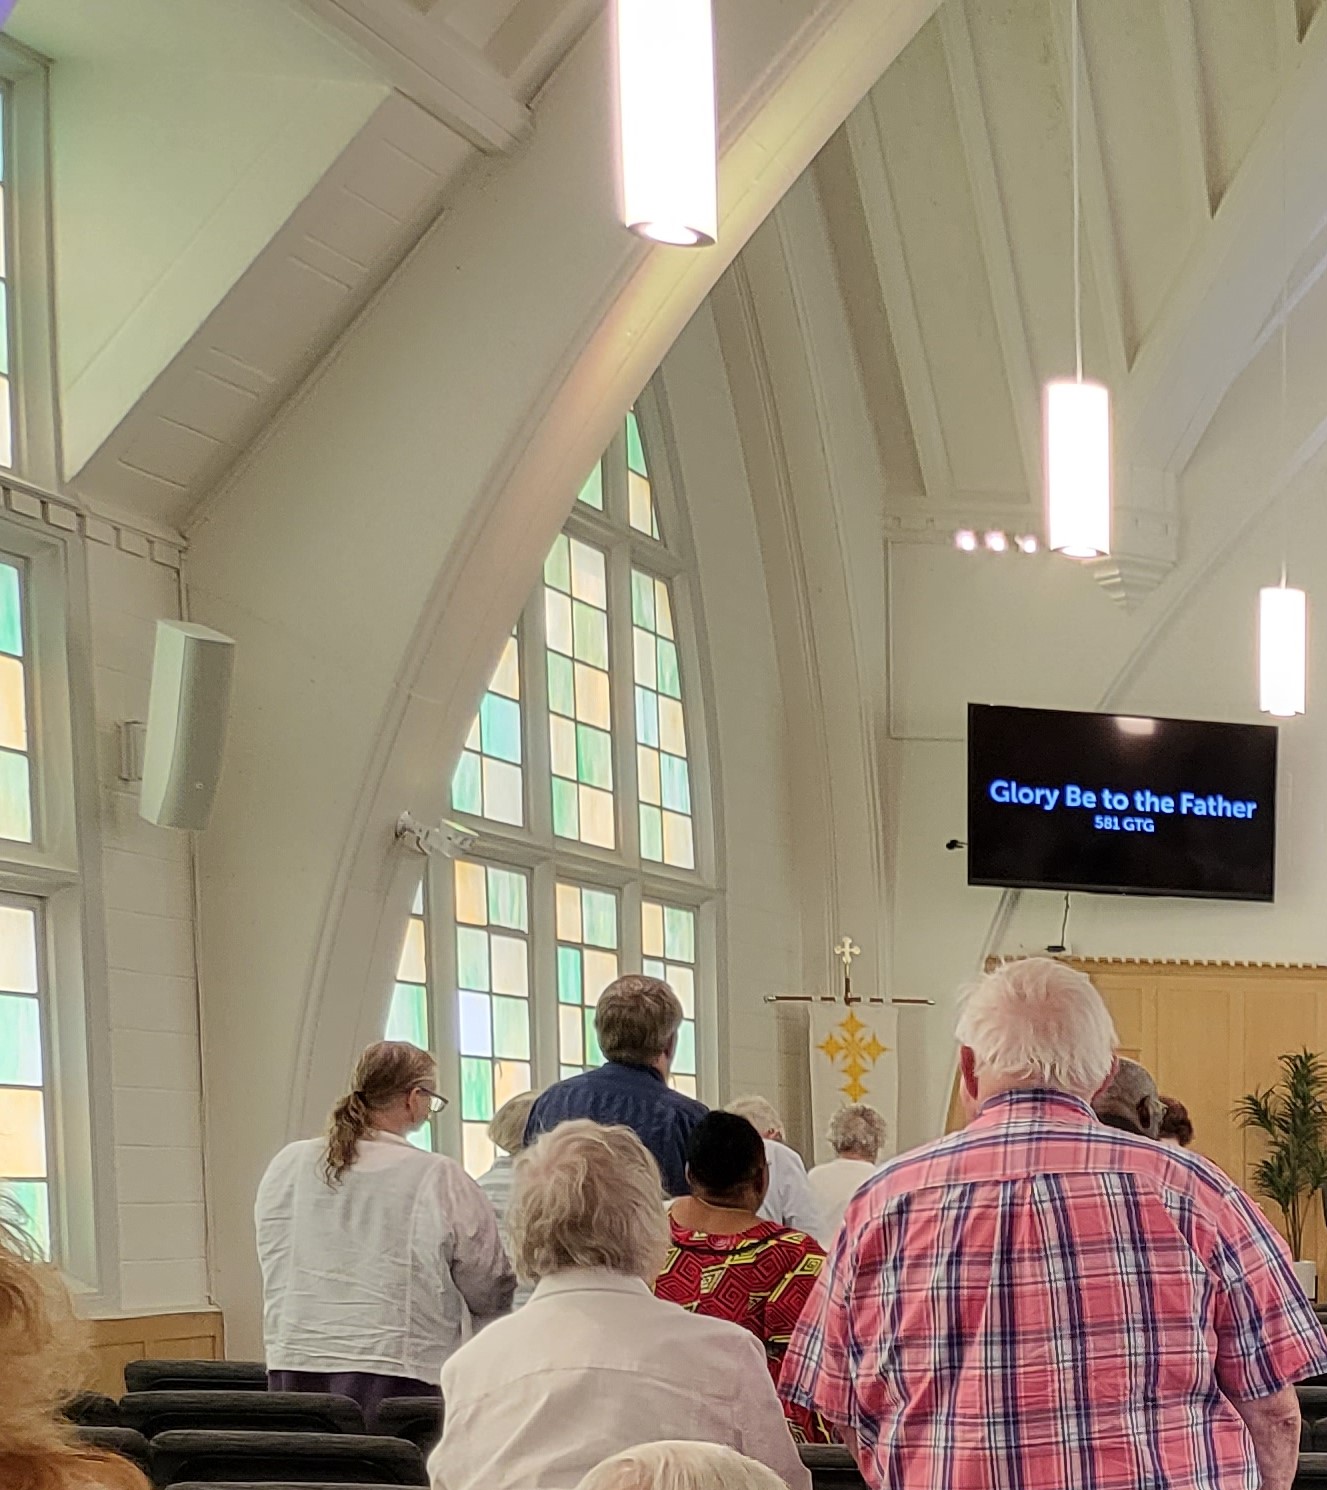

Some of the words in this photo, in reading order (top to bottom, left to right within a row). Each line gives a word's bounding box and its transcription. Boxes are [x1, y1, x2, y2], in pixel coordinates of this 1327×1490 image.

[989, 779, 1060, 811] Glory
[1065, 784, 1097, 808] Be
[1101, 788, 1129, 811] to
[1133, 789, 1175, 814] the
[1180, 792, 1257, 819] Father
[1094, 814, 1121, 830] 581
[1121, 816, 1155, 832] GTG
